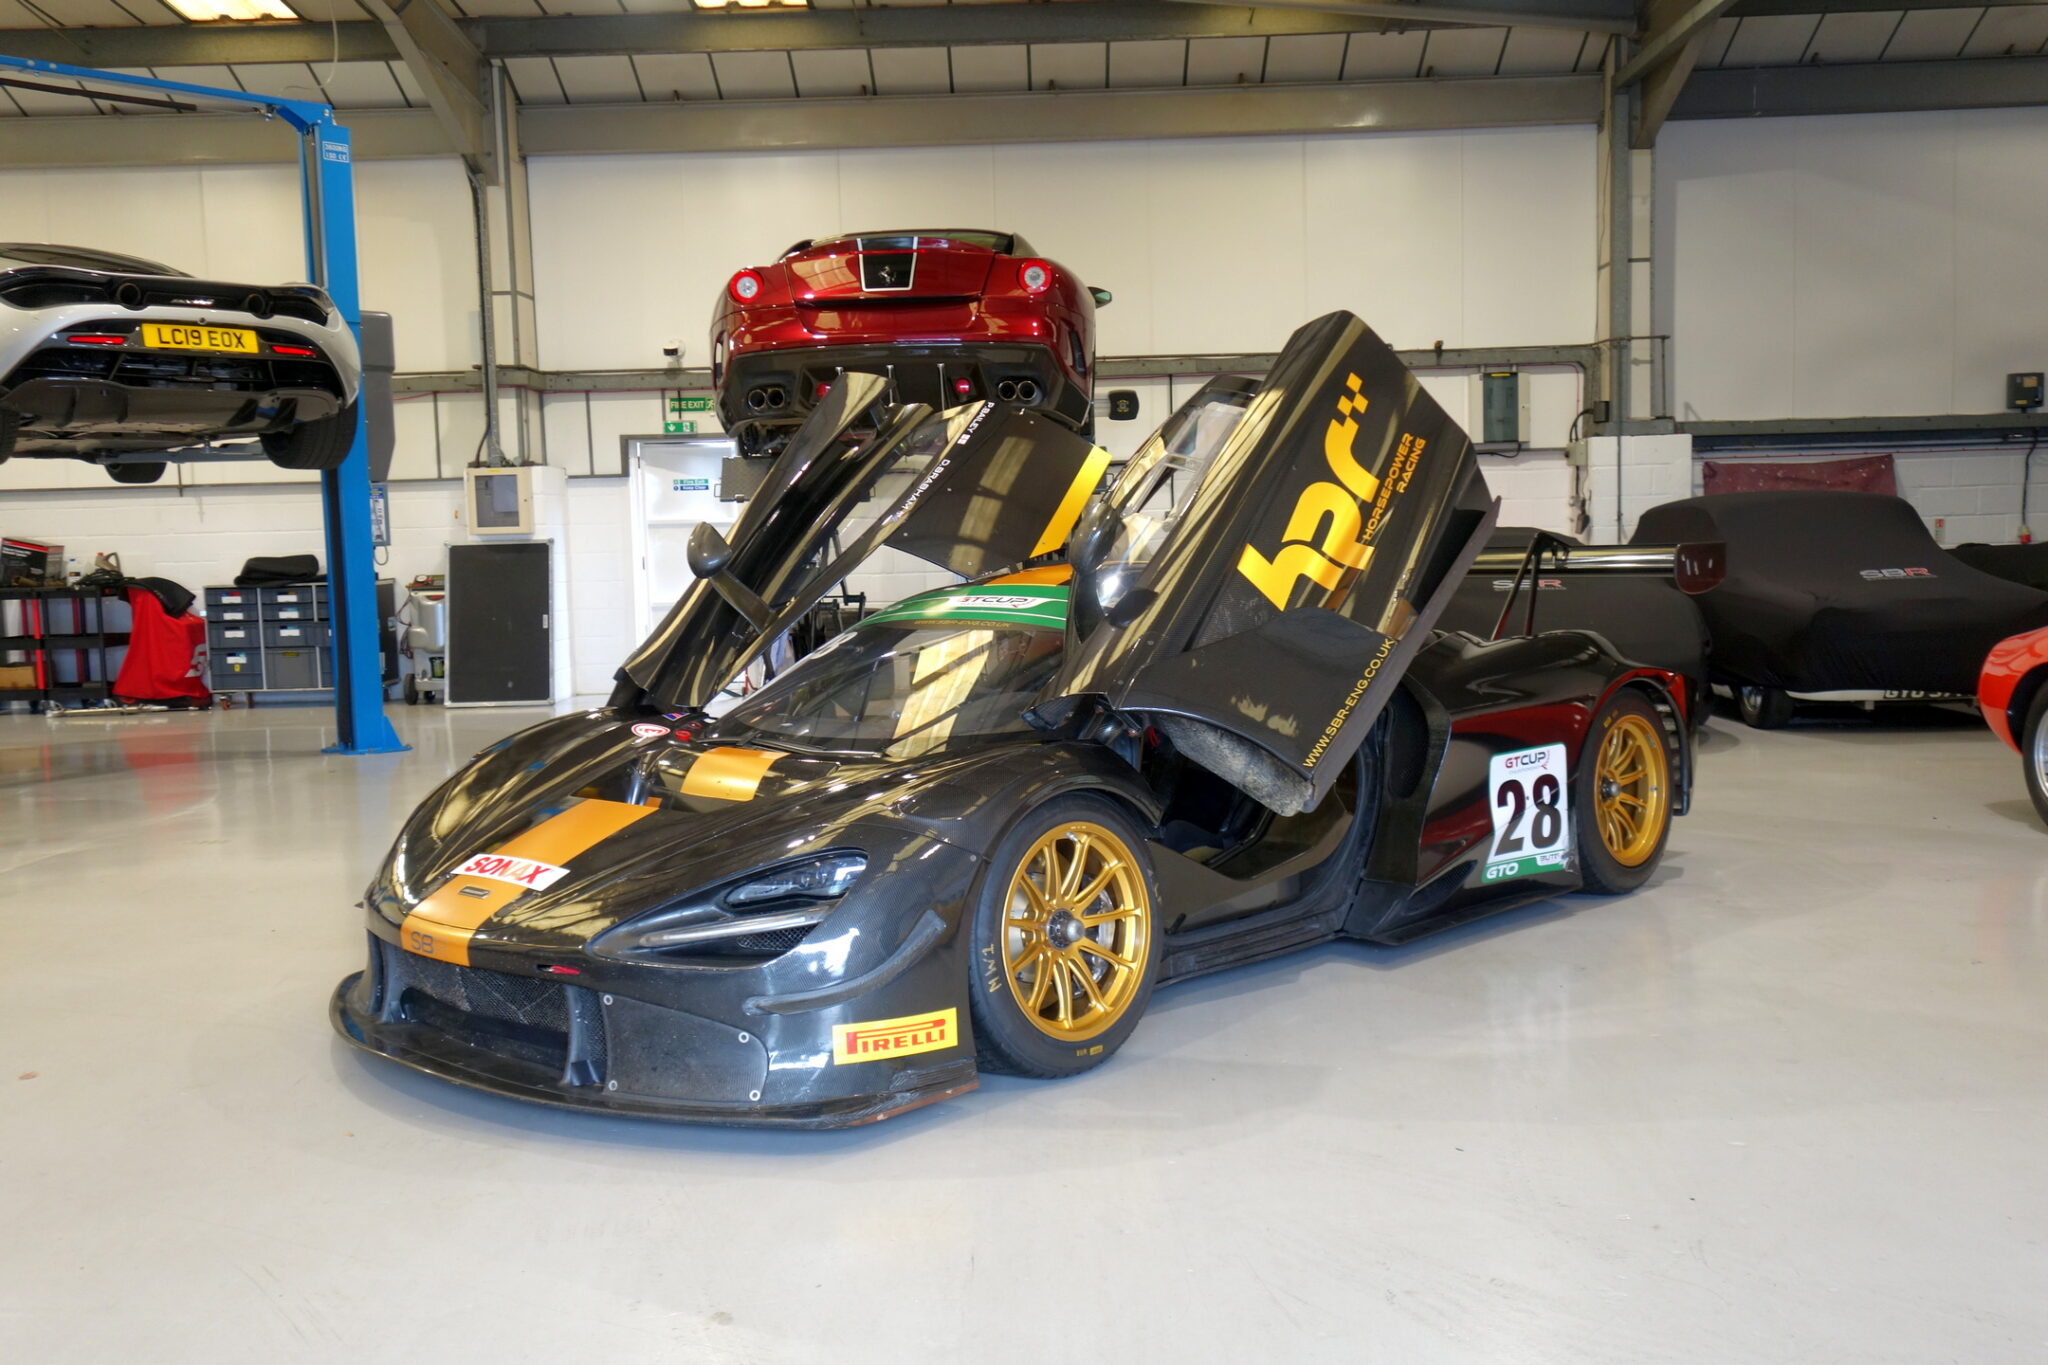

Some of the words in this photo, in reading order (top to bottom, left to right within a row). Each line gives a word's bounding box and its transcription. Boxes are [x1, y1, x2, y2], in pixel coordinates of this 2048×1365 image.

[157, 327, 202, 346] LC19
[207, 330, 245, 349] EOX
[687, 400, 705, 408] EXIT
[966, 401, 995, 433] P.BAILEY
[1396, 437, 1427, 493] RACING
[901, 459, 951, 510] D.BRABHAM
[1362, 432, 1414, 541] HORSEPOWER
[1302, 637, 1396, 769] WWW.SBR-ENG.CO.UK
[1495, 774, 1561, 856] 28
[463, 856, 551, 885] SONAX
[1486, 862, 1519, 879] GTO
[846, 1018, 946, 1055] PIRELLI
